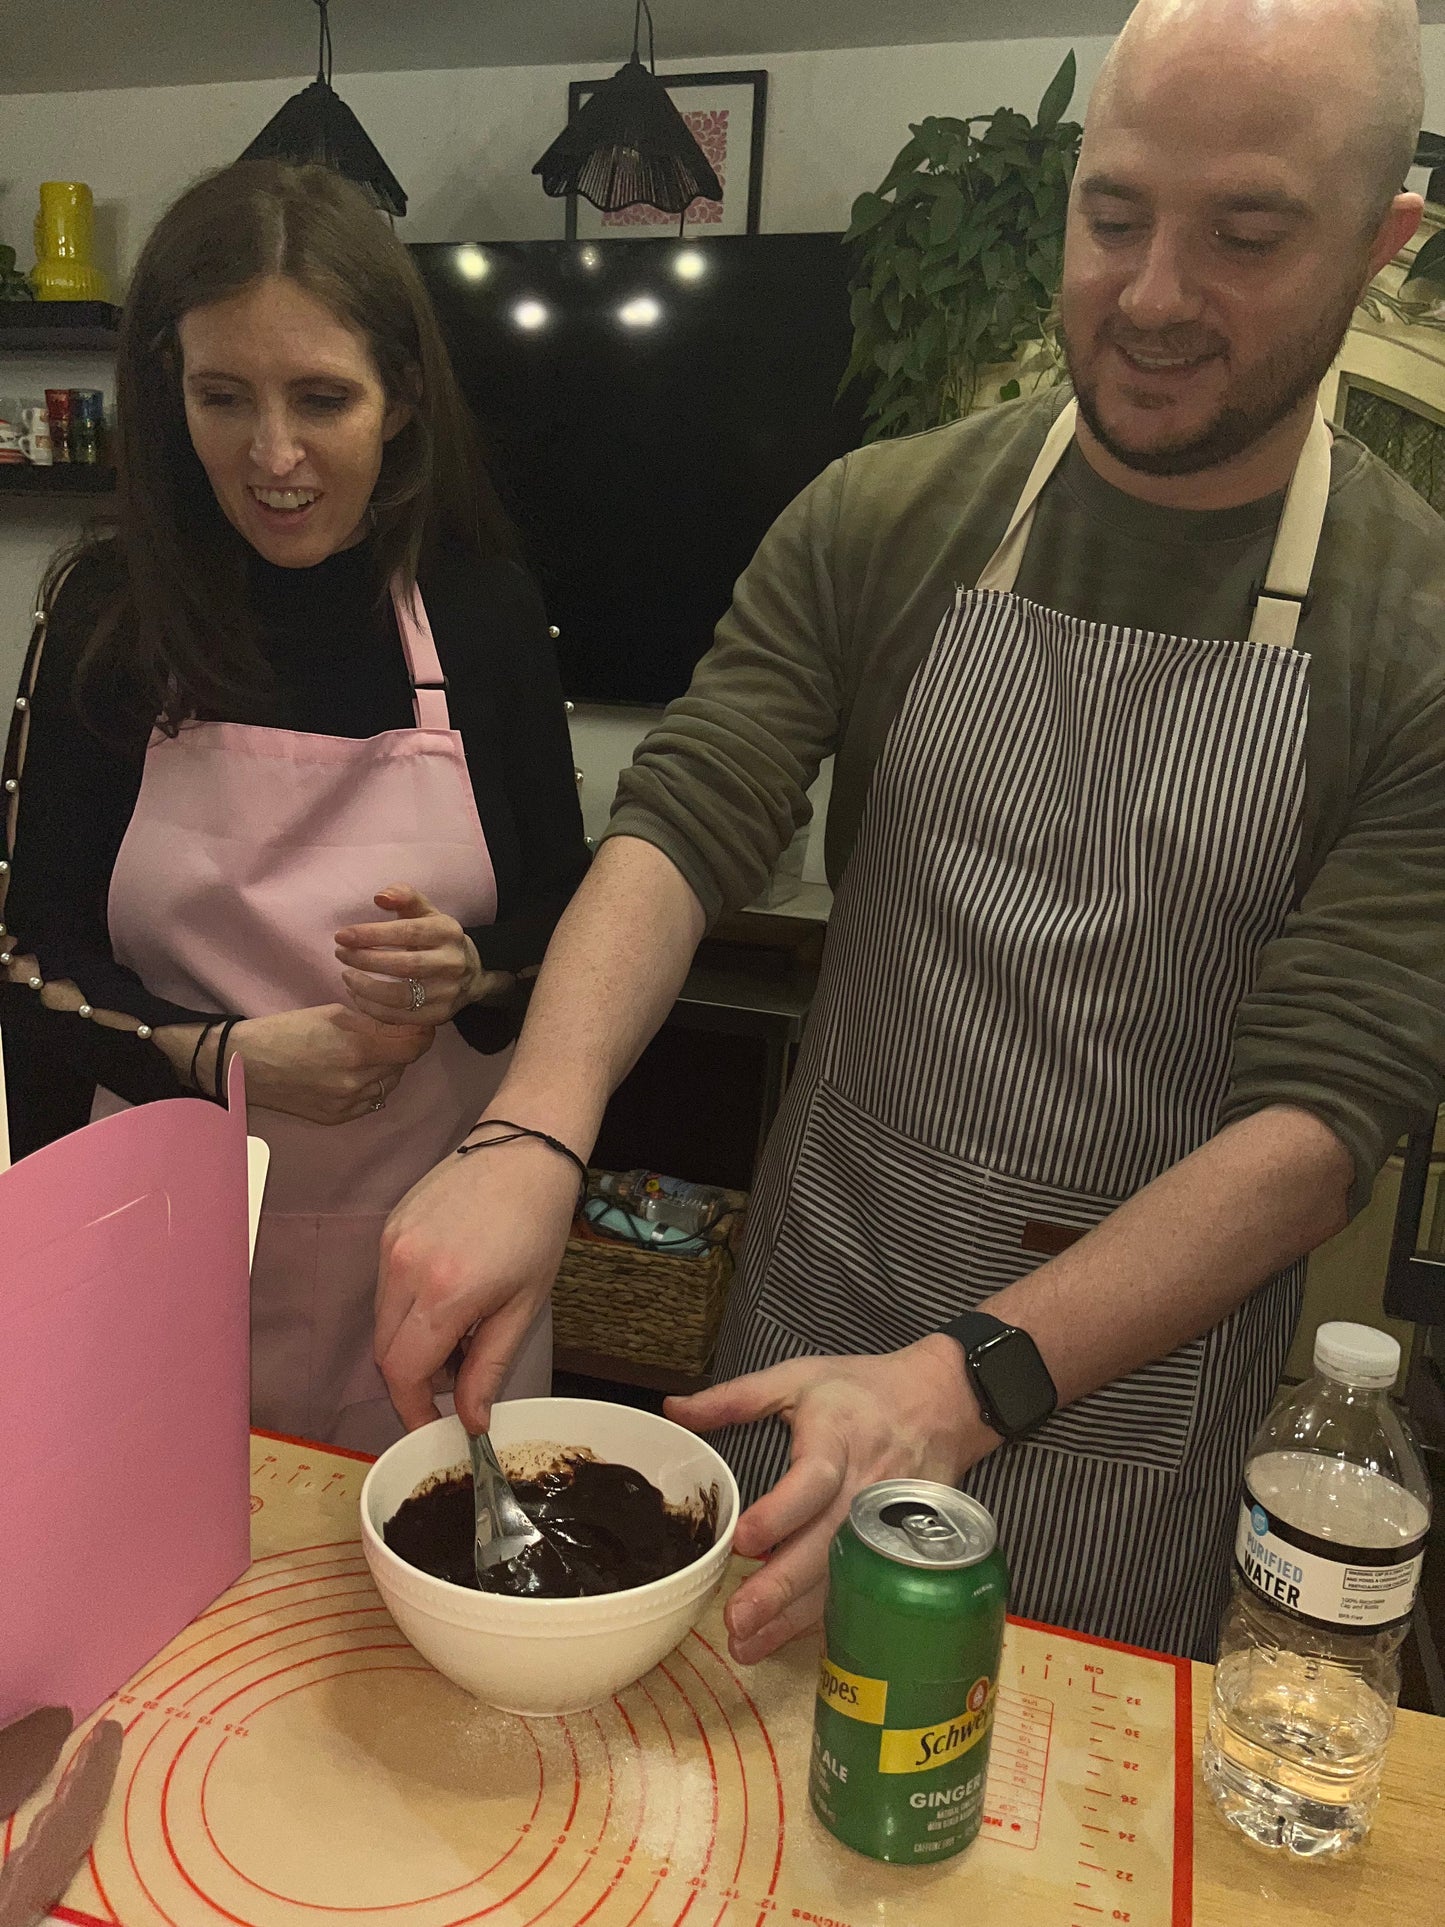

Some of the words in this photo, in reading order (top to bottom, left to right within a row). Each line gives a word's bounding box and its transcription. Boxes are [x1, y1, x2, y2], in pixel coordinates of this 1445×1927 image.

[1247, 1531, 1303, 1583] PURIFIED
[1244, 1549, 1301, 1608] WATER
[1084, 1664, 1104, 1675] CM
[1126, 1696, 1142, 1706] 32
[223, 1723, 250, 1737] 12.5
[914, 1706, 989, 1766] Schwe
[1124, 1728, 1140, 1739] 30
[822, 1749, 848, 1784] ALE
[1122, 1761, 1139, 1771] 28
[909, 1772, 983, 1809] GINGER
[1121, 1794, 1138, 1805] 26
[1118, 1831, 1136, 1842] 24
[1116, 1870, 1133, 1882] 22
[791, 1908, 851, 1927] nches
[1112, 1909, 1130, 1923] 20
